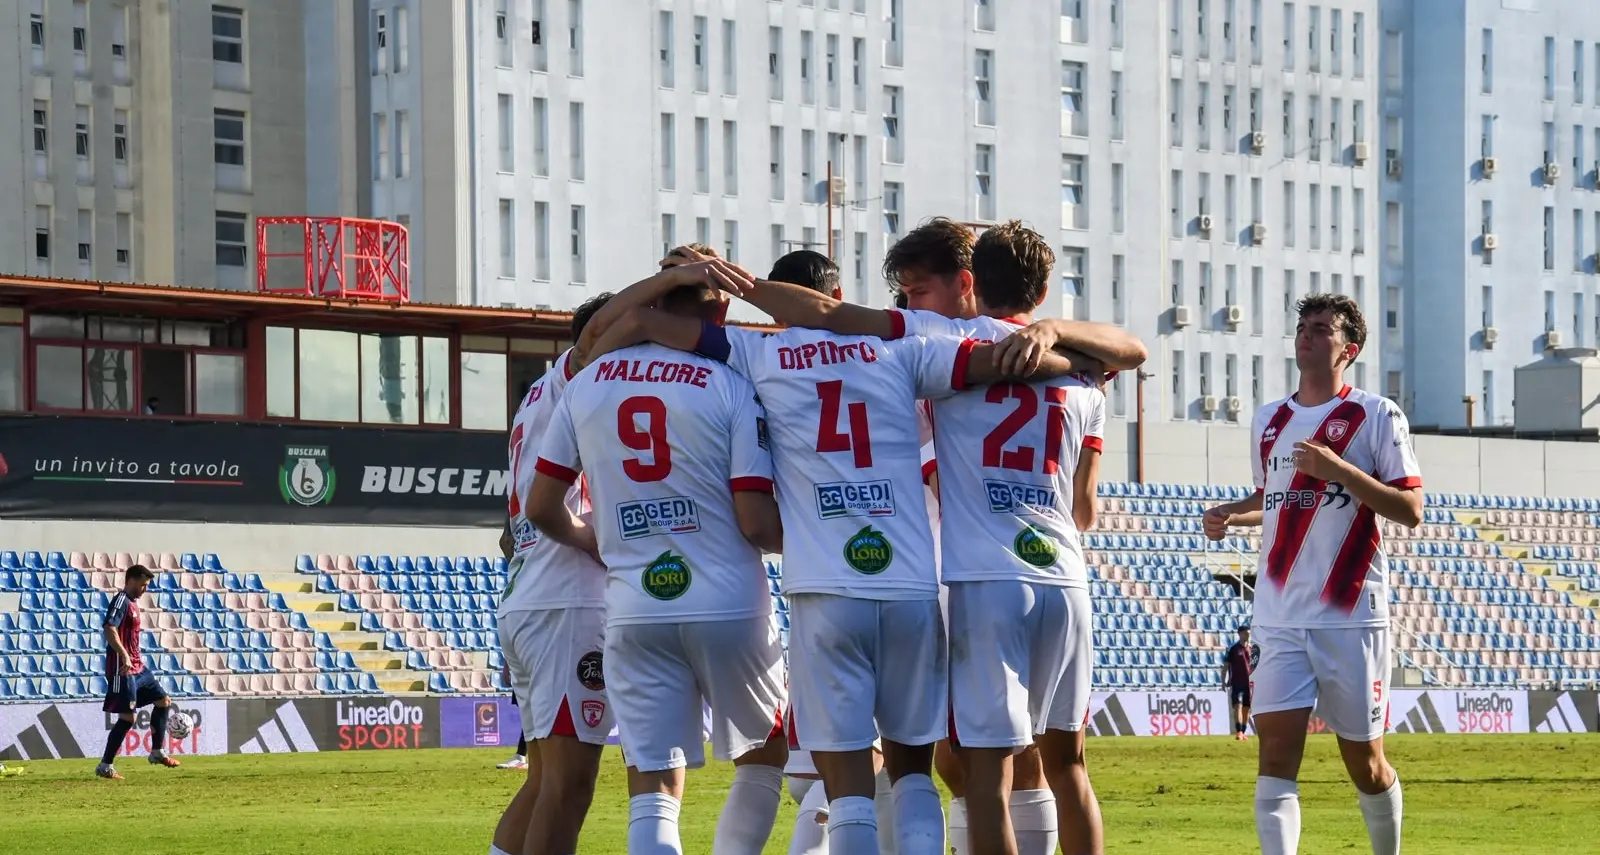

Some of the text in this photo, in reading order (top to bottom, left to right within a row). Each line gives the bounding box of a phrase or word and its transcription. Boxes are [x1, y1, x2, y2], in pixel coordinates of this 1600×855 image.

[594, 360, 713, 389] MALCORE
[816, 380, 872, 468] 4
[983, 382, 1067, 475] 21
[617, 396, 672, 483] 9
[288, 447, 327, 456] BUSCEMA
[35, 456, 240, 477] un invito a tavola
[360, 466, 510, 496] BUSCEM
[845, 483, 890, 501] GEDI
[1012, 486, 1056, 507] GEDI
[1265, 490, 1316, 511] BPPB
[644, 499, 694, 519] GEDI
[650, 519, 672, 527] GROUP
[1373, 681, 1381, 702] 5
[1456, 692, 1513, 712] LineaOro
[336, 700, 423, 725] LineaOro
[1147, 693, 1211, 715] LineaOro
[1150, 713, 1212, 736] SPORT
[1458, 711, 1513, 733] SPORT
[117, 727, 201, 756] PORT
[338, 724, 423, 750] SPORT
